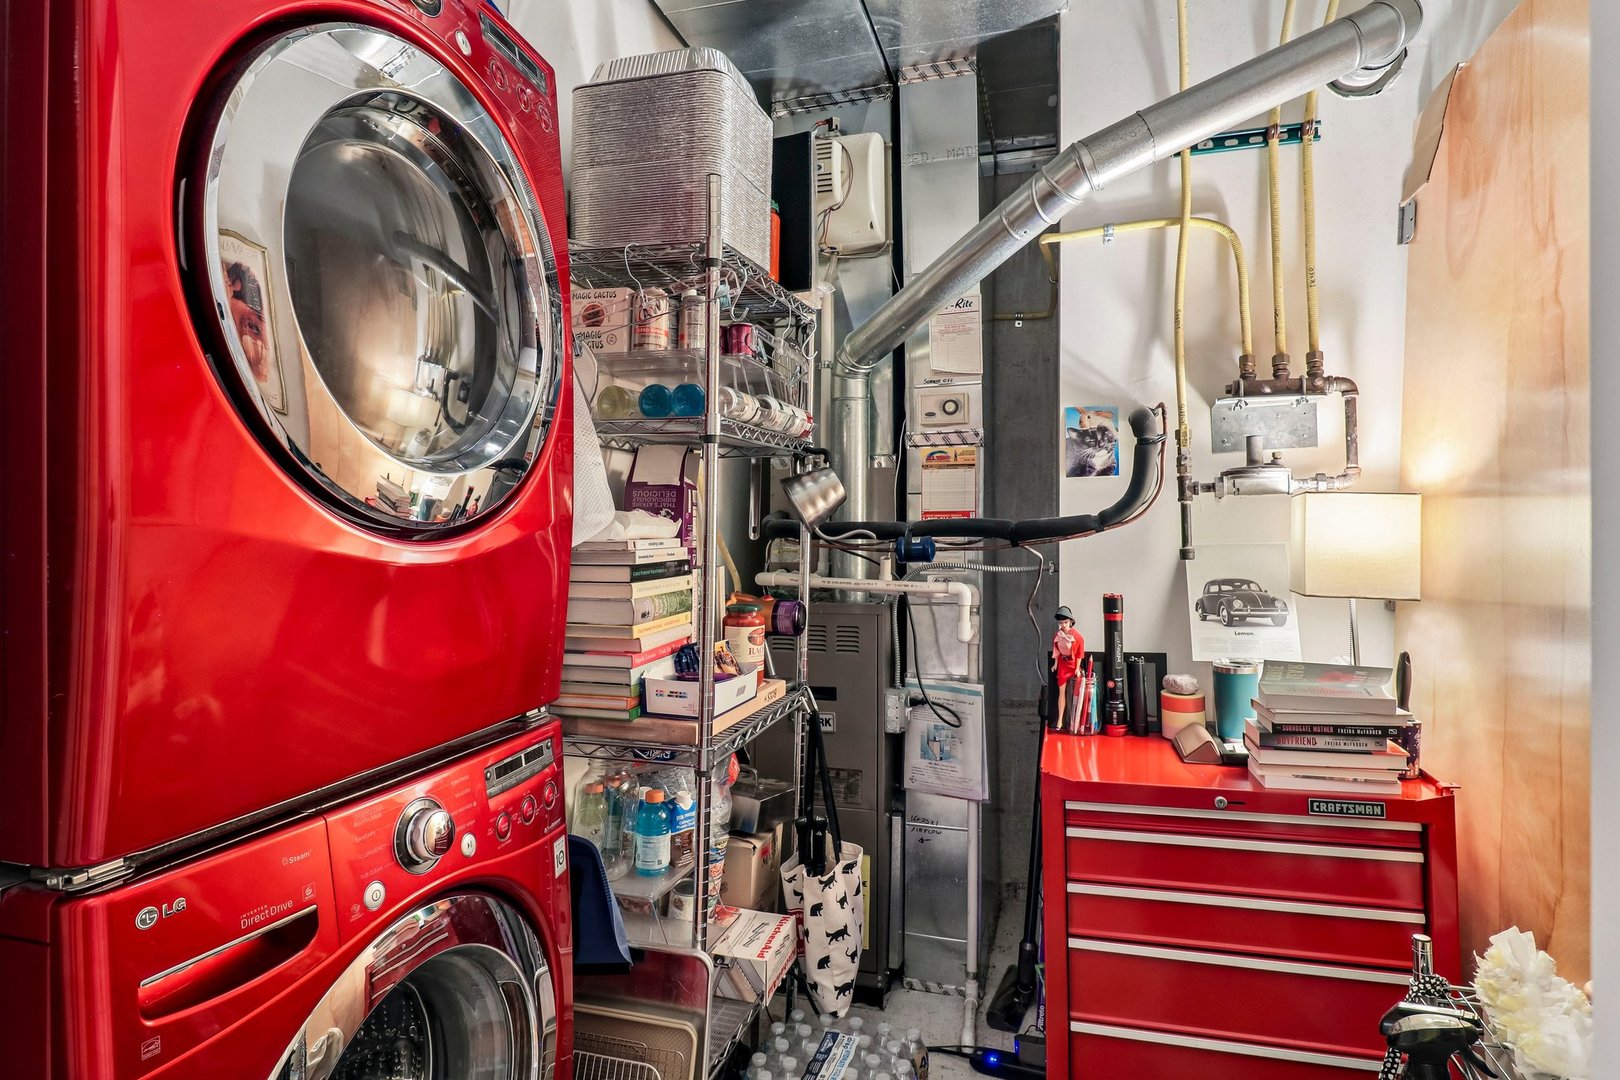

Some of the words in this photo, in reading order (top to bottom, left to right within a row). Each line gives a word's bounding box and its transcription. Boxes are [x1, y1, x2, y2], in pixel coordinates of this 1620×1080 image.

[572, 292, 592, 300] MAGIC
[594, 290, 617, 300] CACTUS
[1276, 736, 1317, 746] BOYFRIEND
[1313, 802, 1382, 815] CRAFTSMAN
[911, 827, 942, 835] AIRFLOW
[288, 850, 310, 864] Steam
[162, 897, 186, 918] LG
[756, 916, 790, 959] KitchenAid
